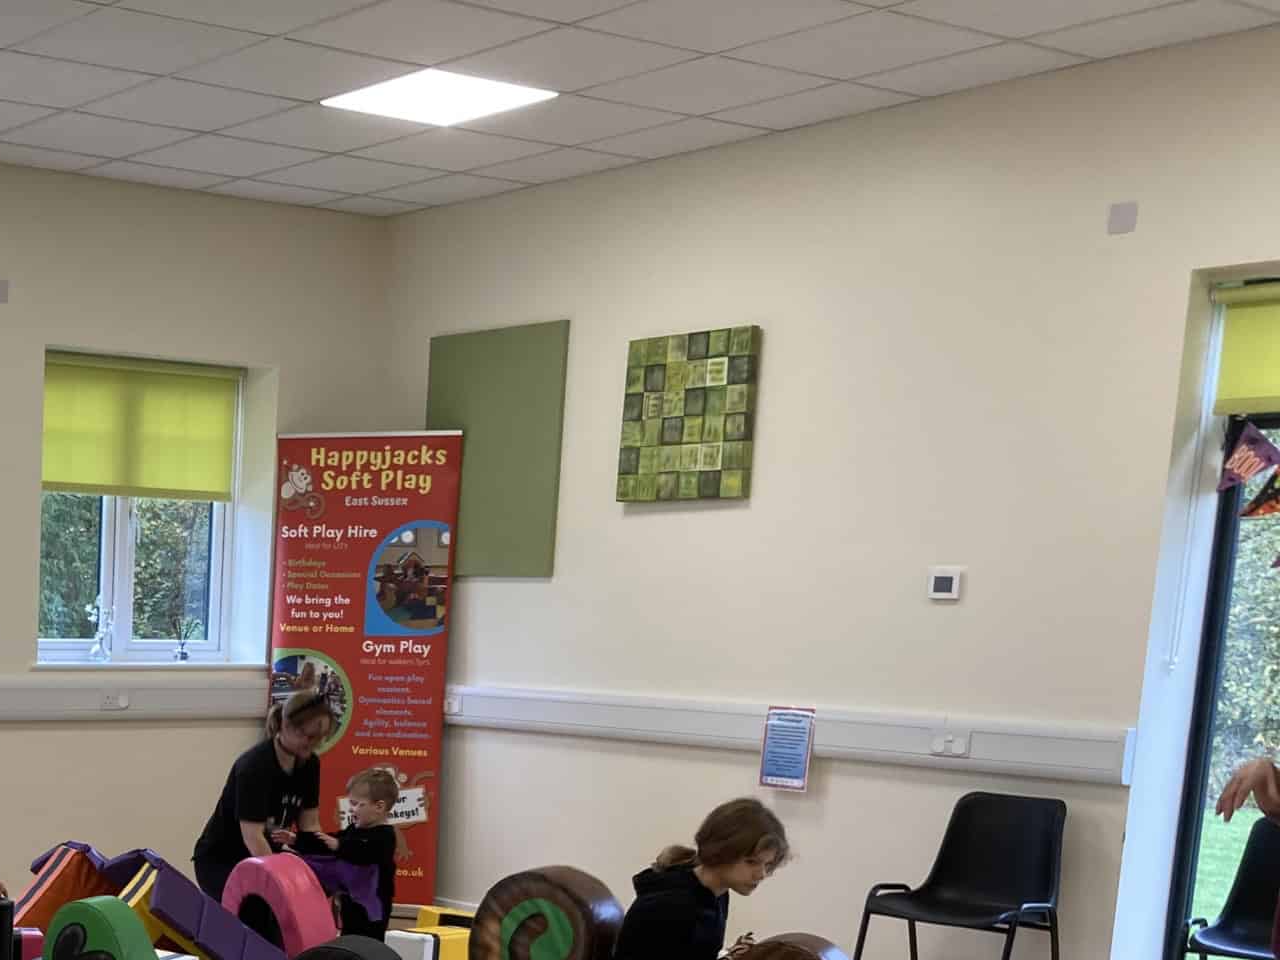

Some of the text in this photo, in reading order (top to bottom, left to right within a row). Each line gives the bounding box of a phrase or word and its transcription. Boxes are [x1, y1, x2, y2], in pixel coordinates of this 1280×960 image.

[310, 445, 448, 471] Happyjacks
[321, 470, 433, 495] Soft Play
[344, 496, 409, 507] East Sussex
[281, 523, 378, 542] Soft Play Hire
[286, 593, 351, 607] We bring the
[290, 607, 344, 621] fun to you!
[279, 623, 355, 633] Venue or Home
[362, 639, 432, 658] Gym Play
[351, 744, 429, 757] Various Venues
